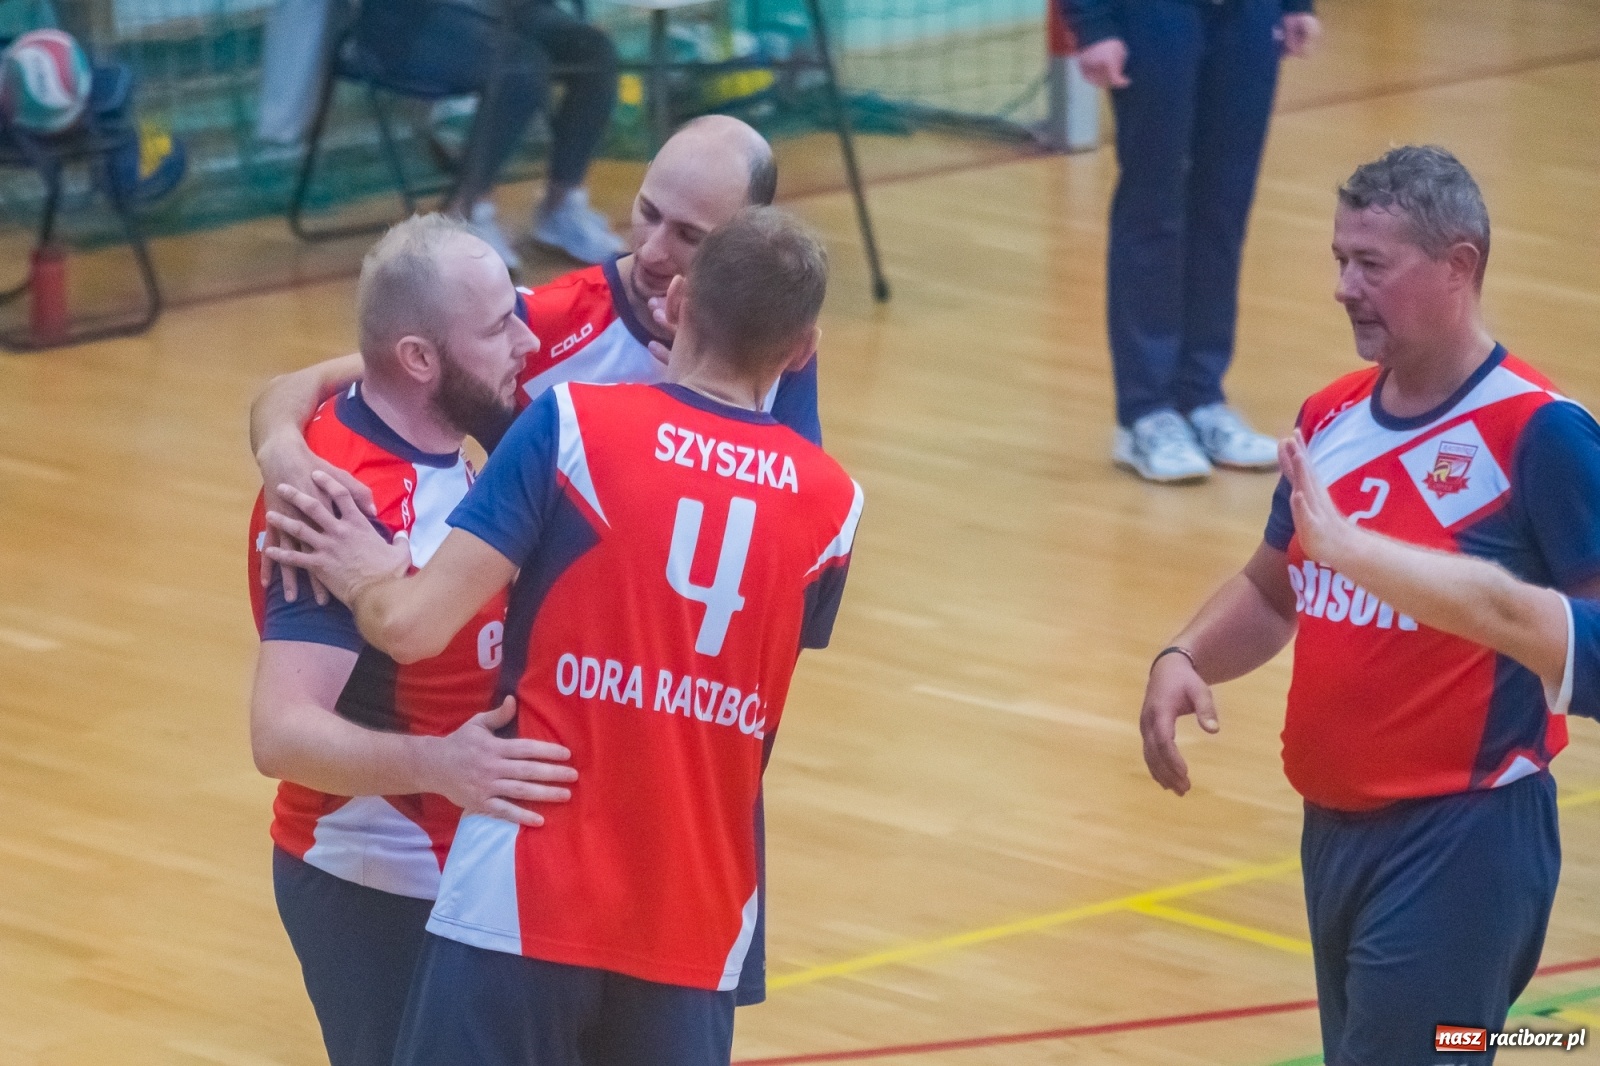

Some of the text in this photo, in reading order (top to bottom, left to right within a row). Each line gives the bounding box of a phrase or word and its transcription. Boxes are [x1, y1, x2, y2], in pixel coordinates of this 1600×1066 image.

[551, 322, 594, 358] COLO
[654, 422, 799, 494] SZYSZKA
[1347, 477, 1391, 526] 2
[665, 496, 757, 658] 4
[556, 652, 644, 708] ODRA
